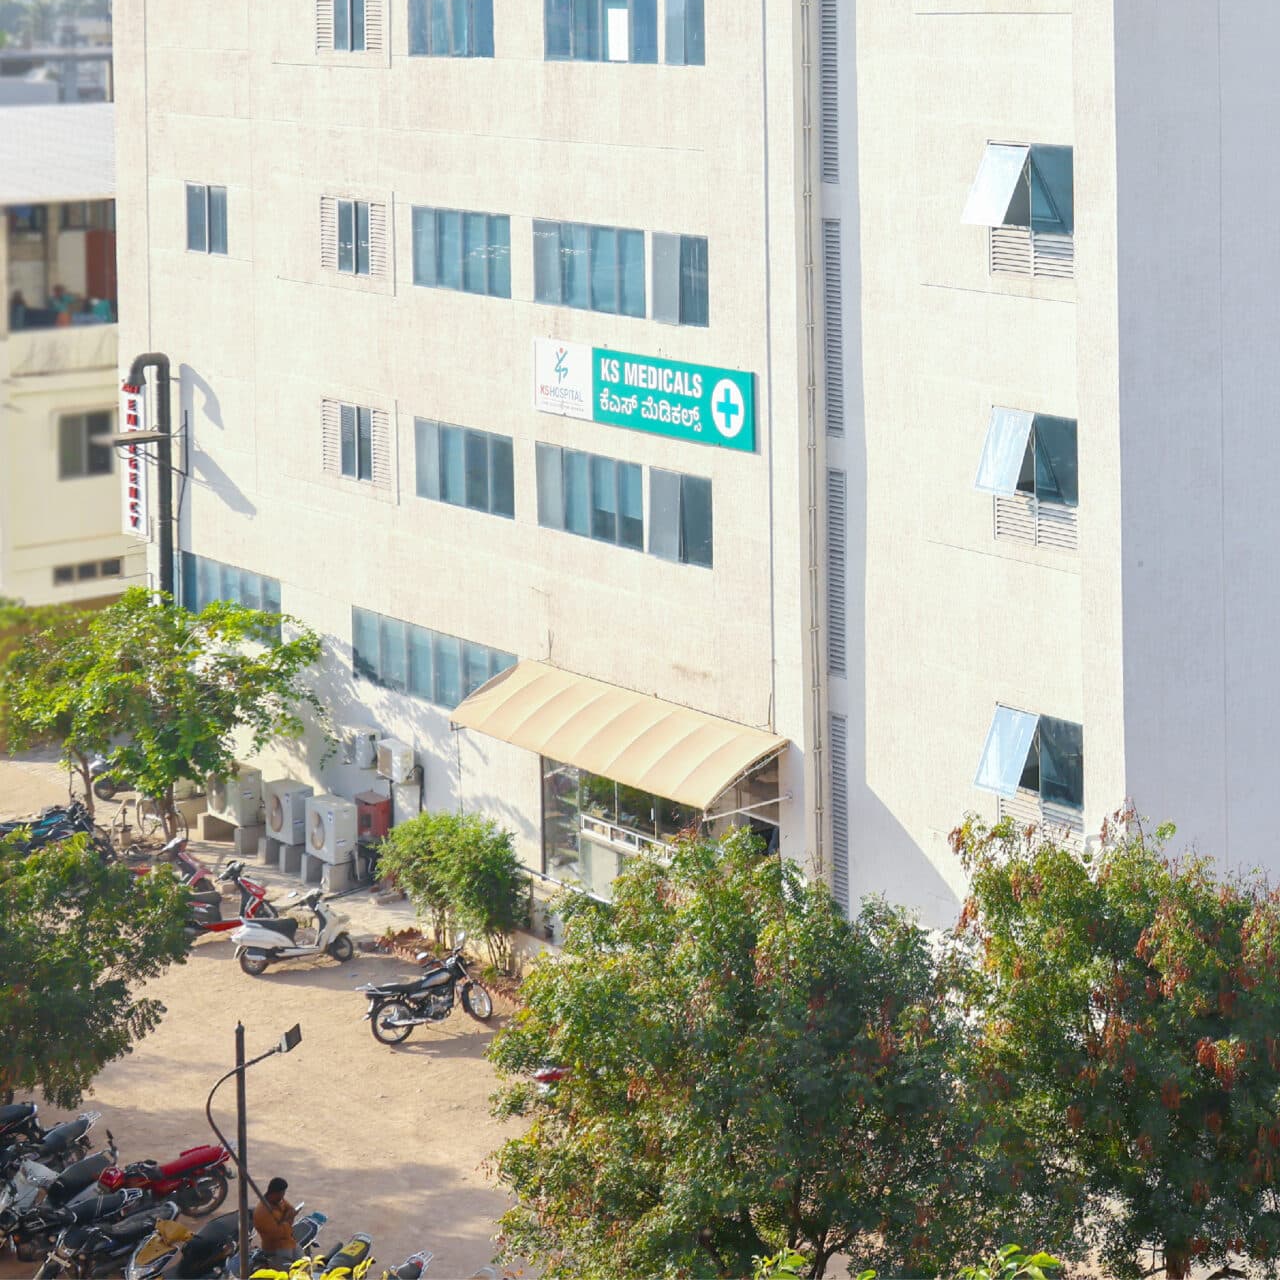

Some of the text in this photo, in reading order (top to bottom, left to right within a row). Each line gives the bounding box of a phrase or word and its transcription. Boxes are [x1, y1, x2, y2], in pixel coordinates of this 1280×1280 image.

[600, 357, 703, 399] KS MEDICALS
[126, 398, 140, 528] EMRGENCY
